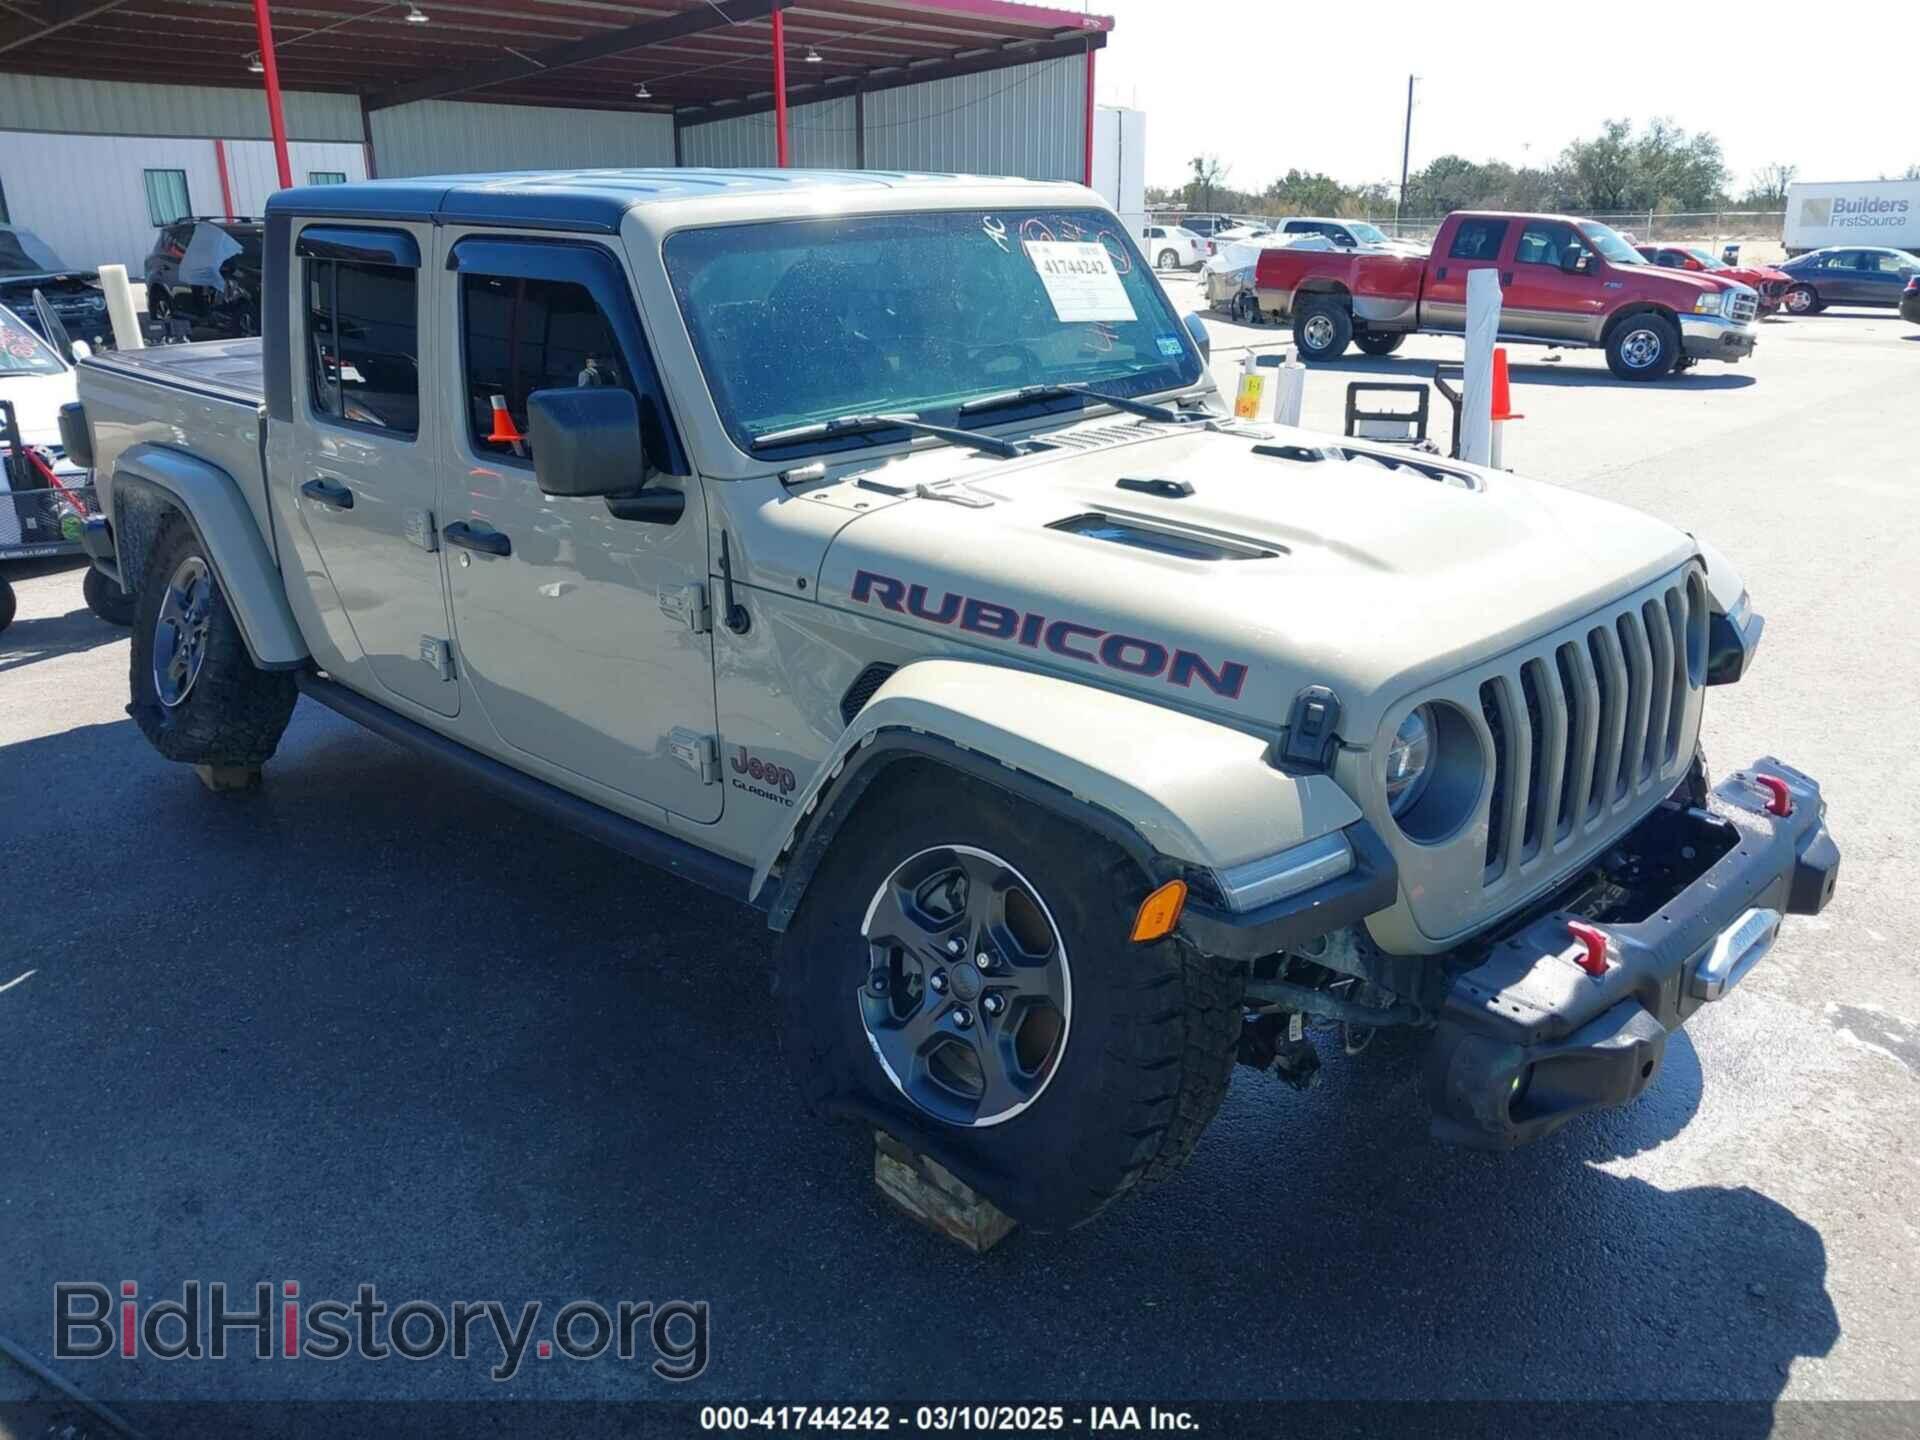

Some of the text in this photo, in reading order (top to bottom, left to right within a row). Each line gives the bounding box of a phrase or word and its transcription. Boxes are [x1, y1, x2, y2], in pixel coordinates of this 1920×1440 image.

[1832, 196, 1909, 214] Builders
[1831, 214, 1907, 227] FirstSource
[1043, 258, 1108, 275] 41744242
[850, 569, 1249, 700] RUBICON
[730, 745, 796, 796] Jeep
